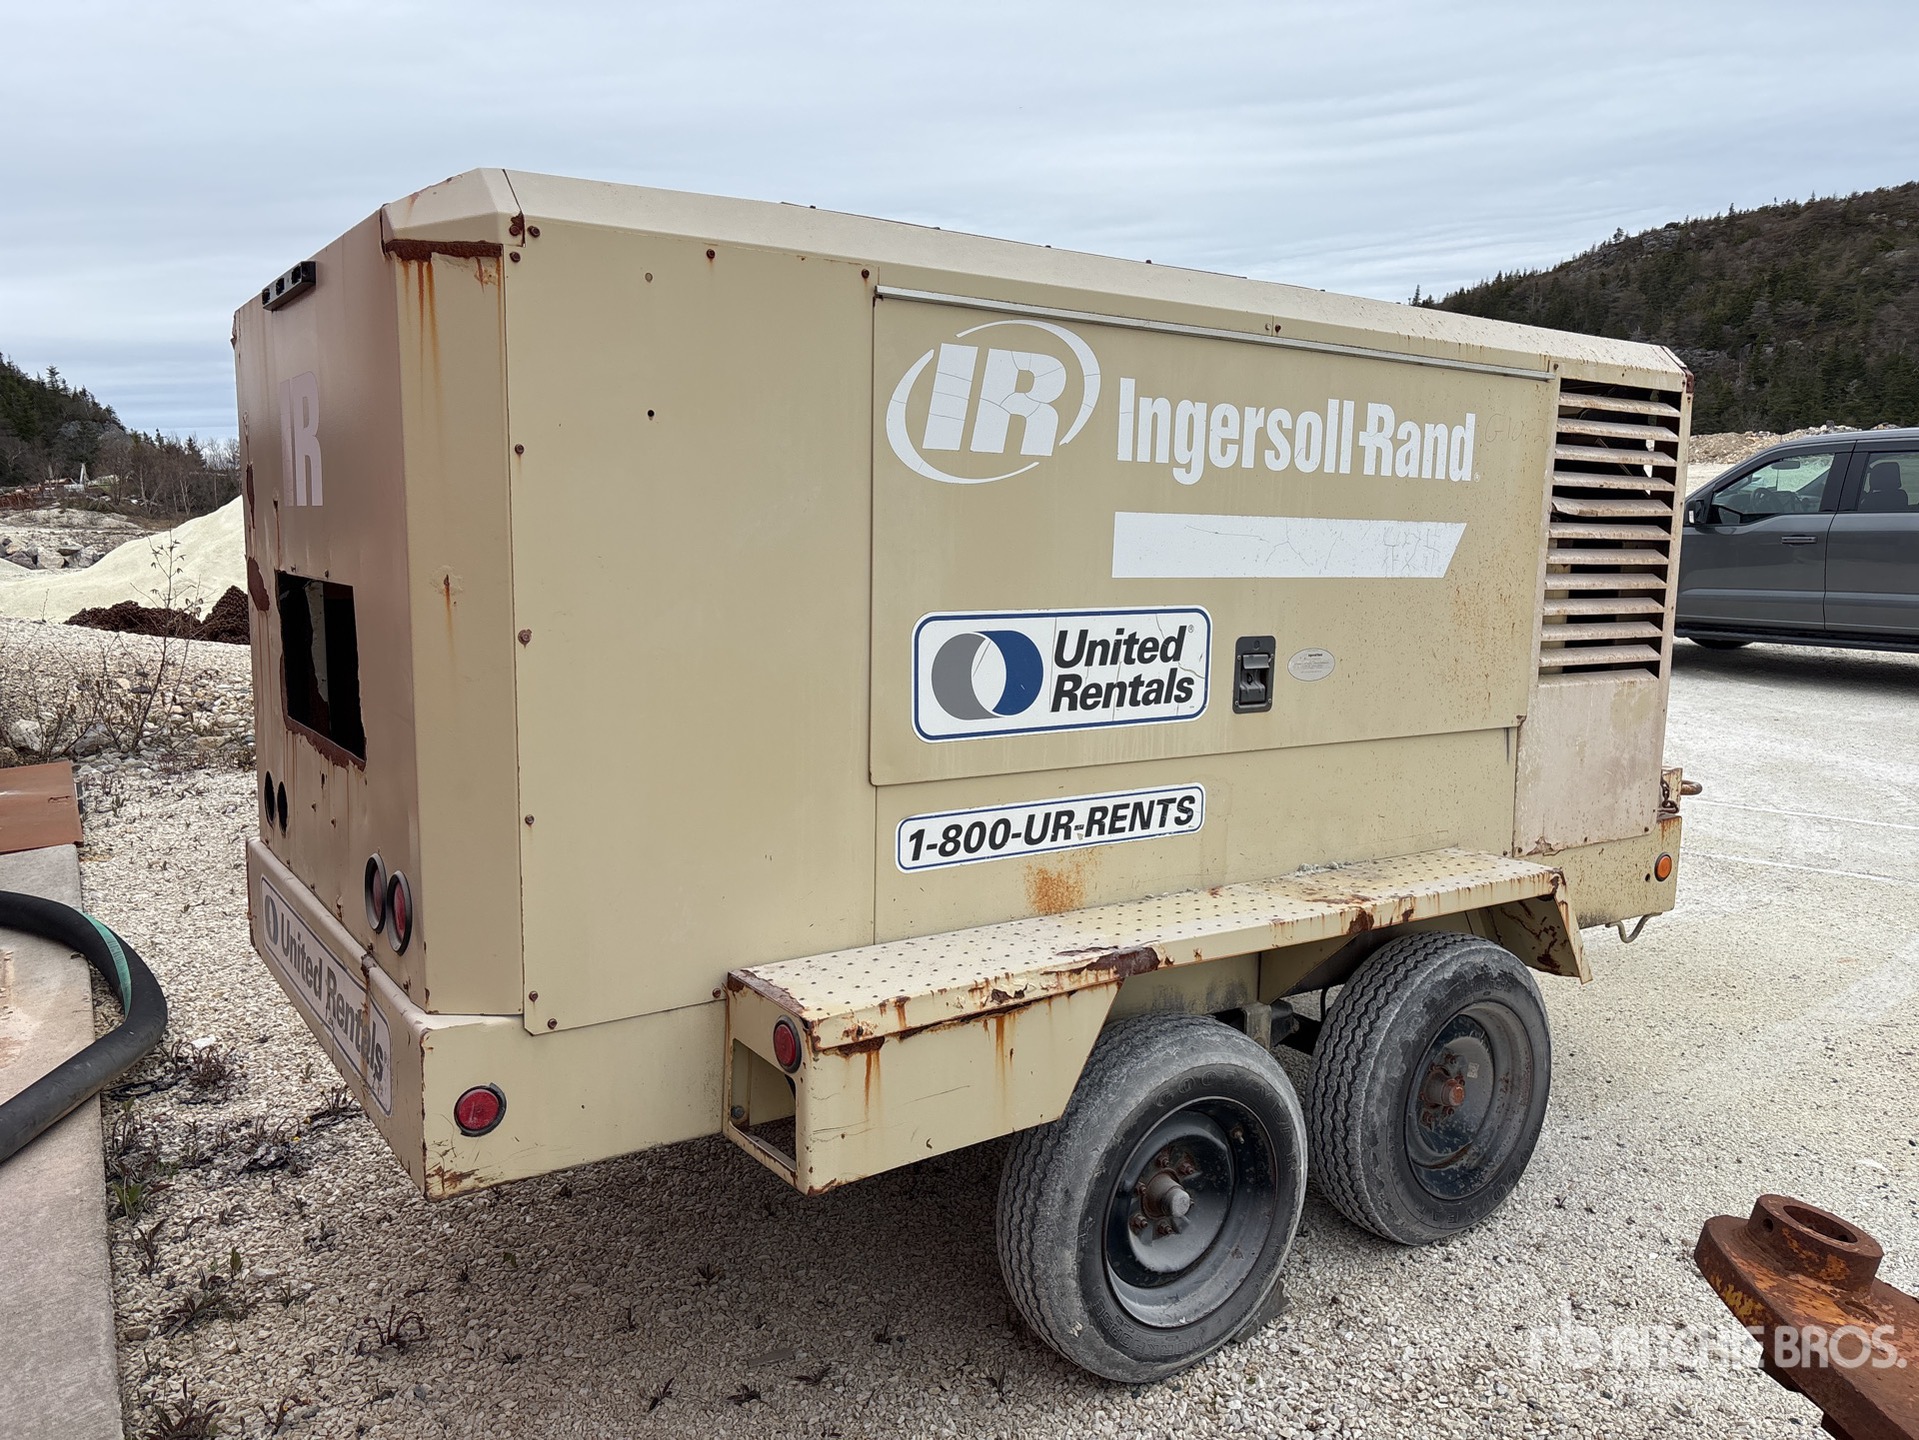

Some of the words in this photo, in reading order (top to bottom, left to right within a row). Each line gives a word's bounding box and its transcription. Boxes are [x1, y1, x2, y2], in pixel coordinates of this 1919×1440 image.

[279, 371, 324, 507] IR
[922, 343, 1067, 457] IR
[1050, 667, 1194, 713] Rentals
[1054, 625, 1187, 668] United
[908, 795, 1196, 862] 1-800-UR-RENTS
[280, 912, 323, 1002] United
[325, 970, 384, 1082] Rentals
